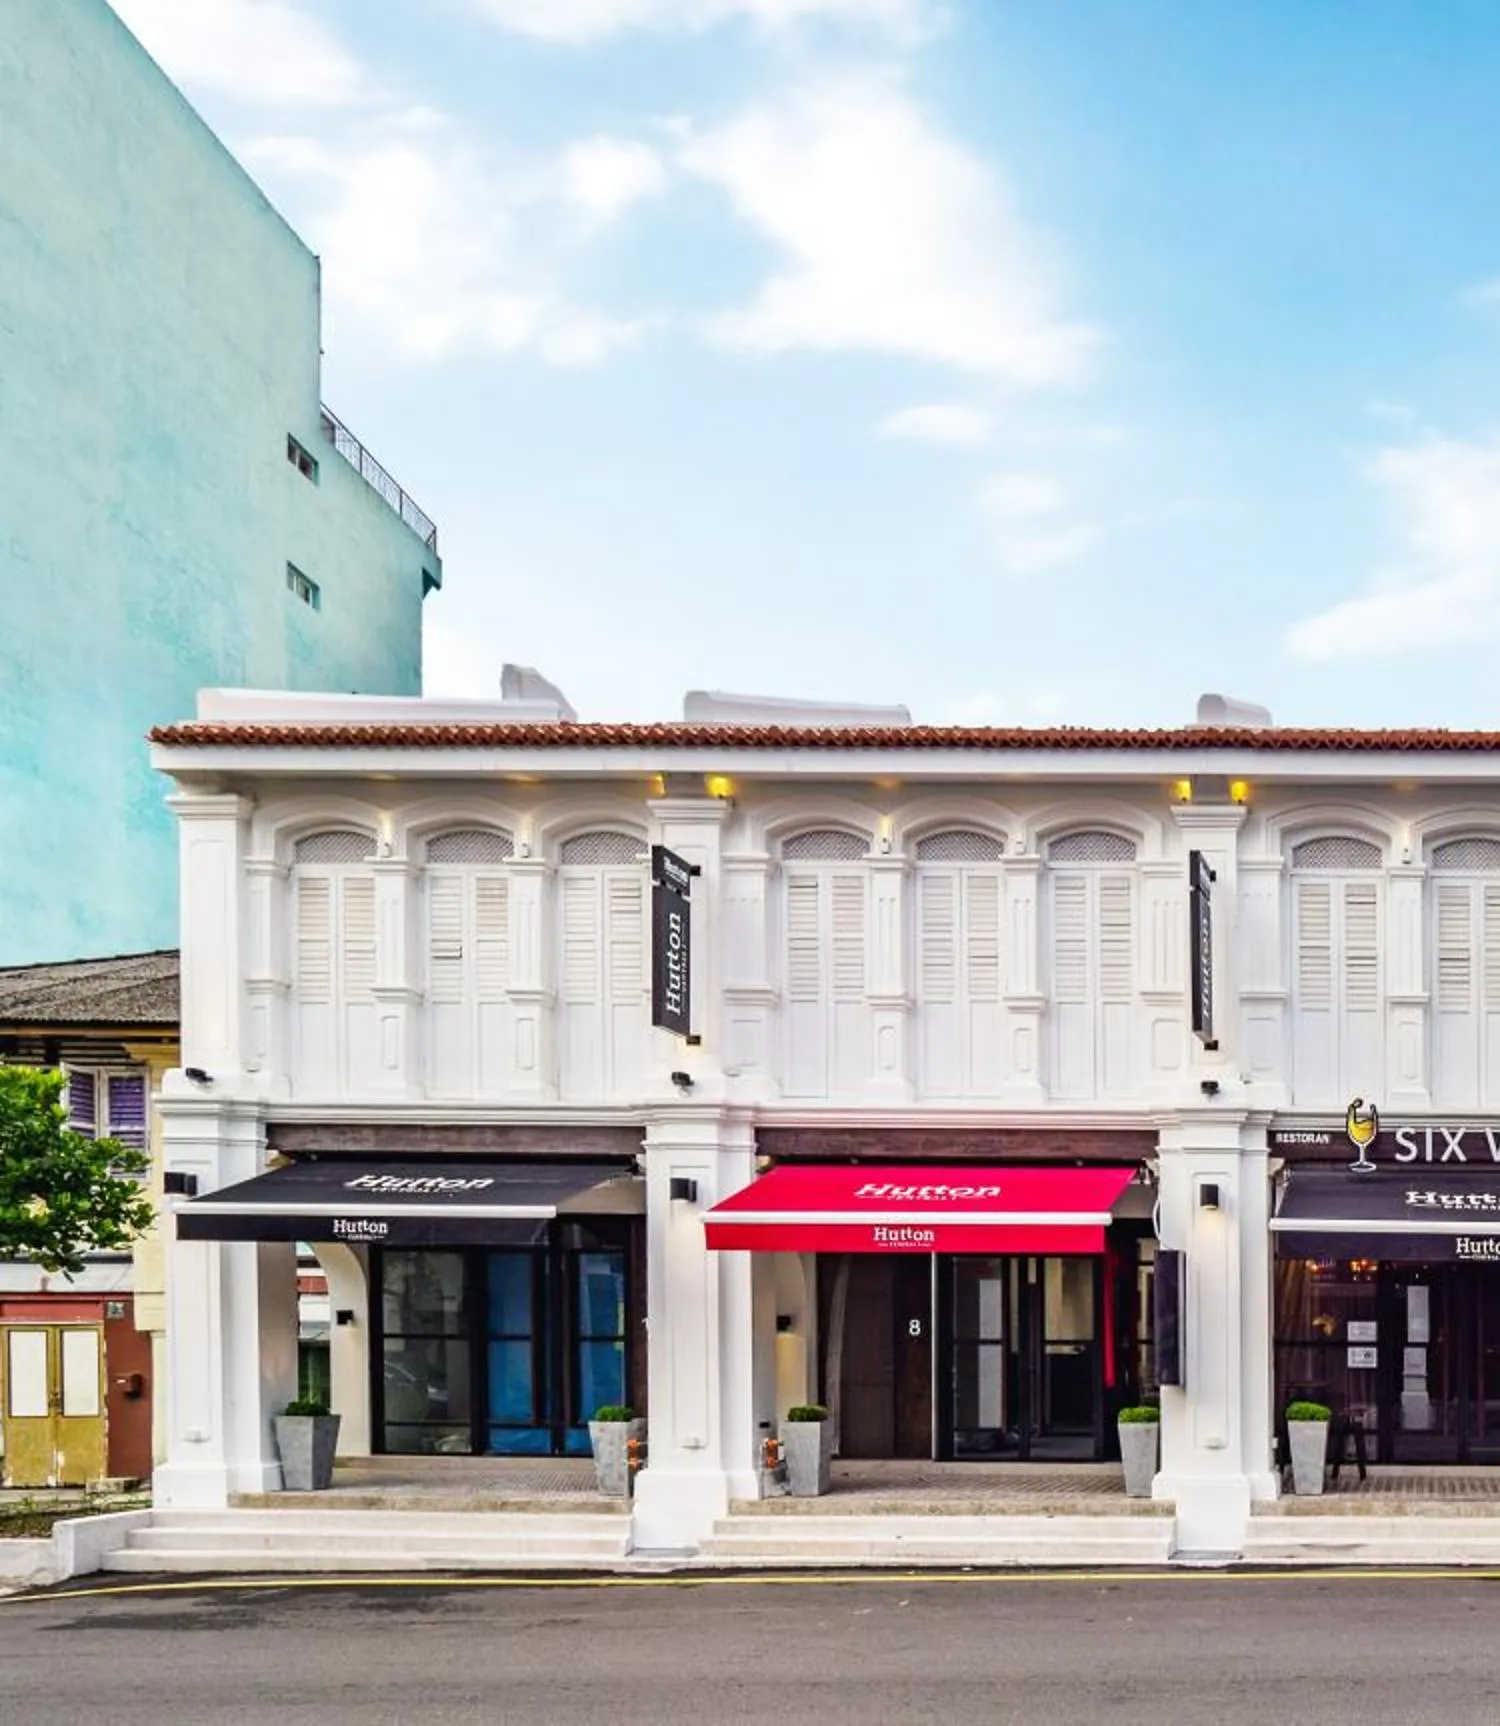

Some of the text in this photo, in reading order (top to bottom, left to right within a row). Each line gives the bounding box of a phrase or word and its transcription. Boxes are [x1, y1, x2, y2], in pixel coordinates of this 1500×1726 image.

[665, 912, 681, 1016] Hutton
[1275, 1133, 1329, 1145] RESTORAN
[1395, 1127, 1467, 1162] SIX
[343, 1175, 495, 1190] Hutton
[852, 1184, 1002, 1199] Hutton
[333, 1219, 389, 1234] Hutton
[873, 1226, 935, 1241] Hutton
[909, 1319, 921, 1336] 8
